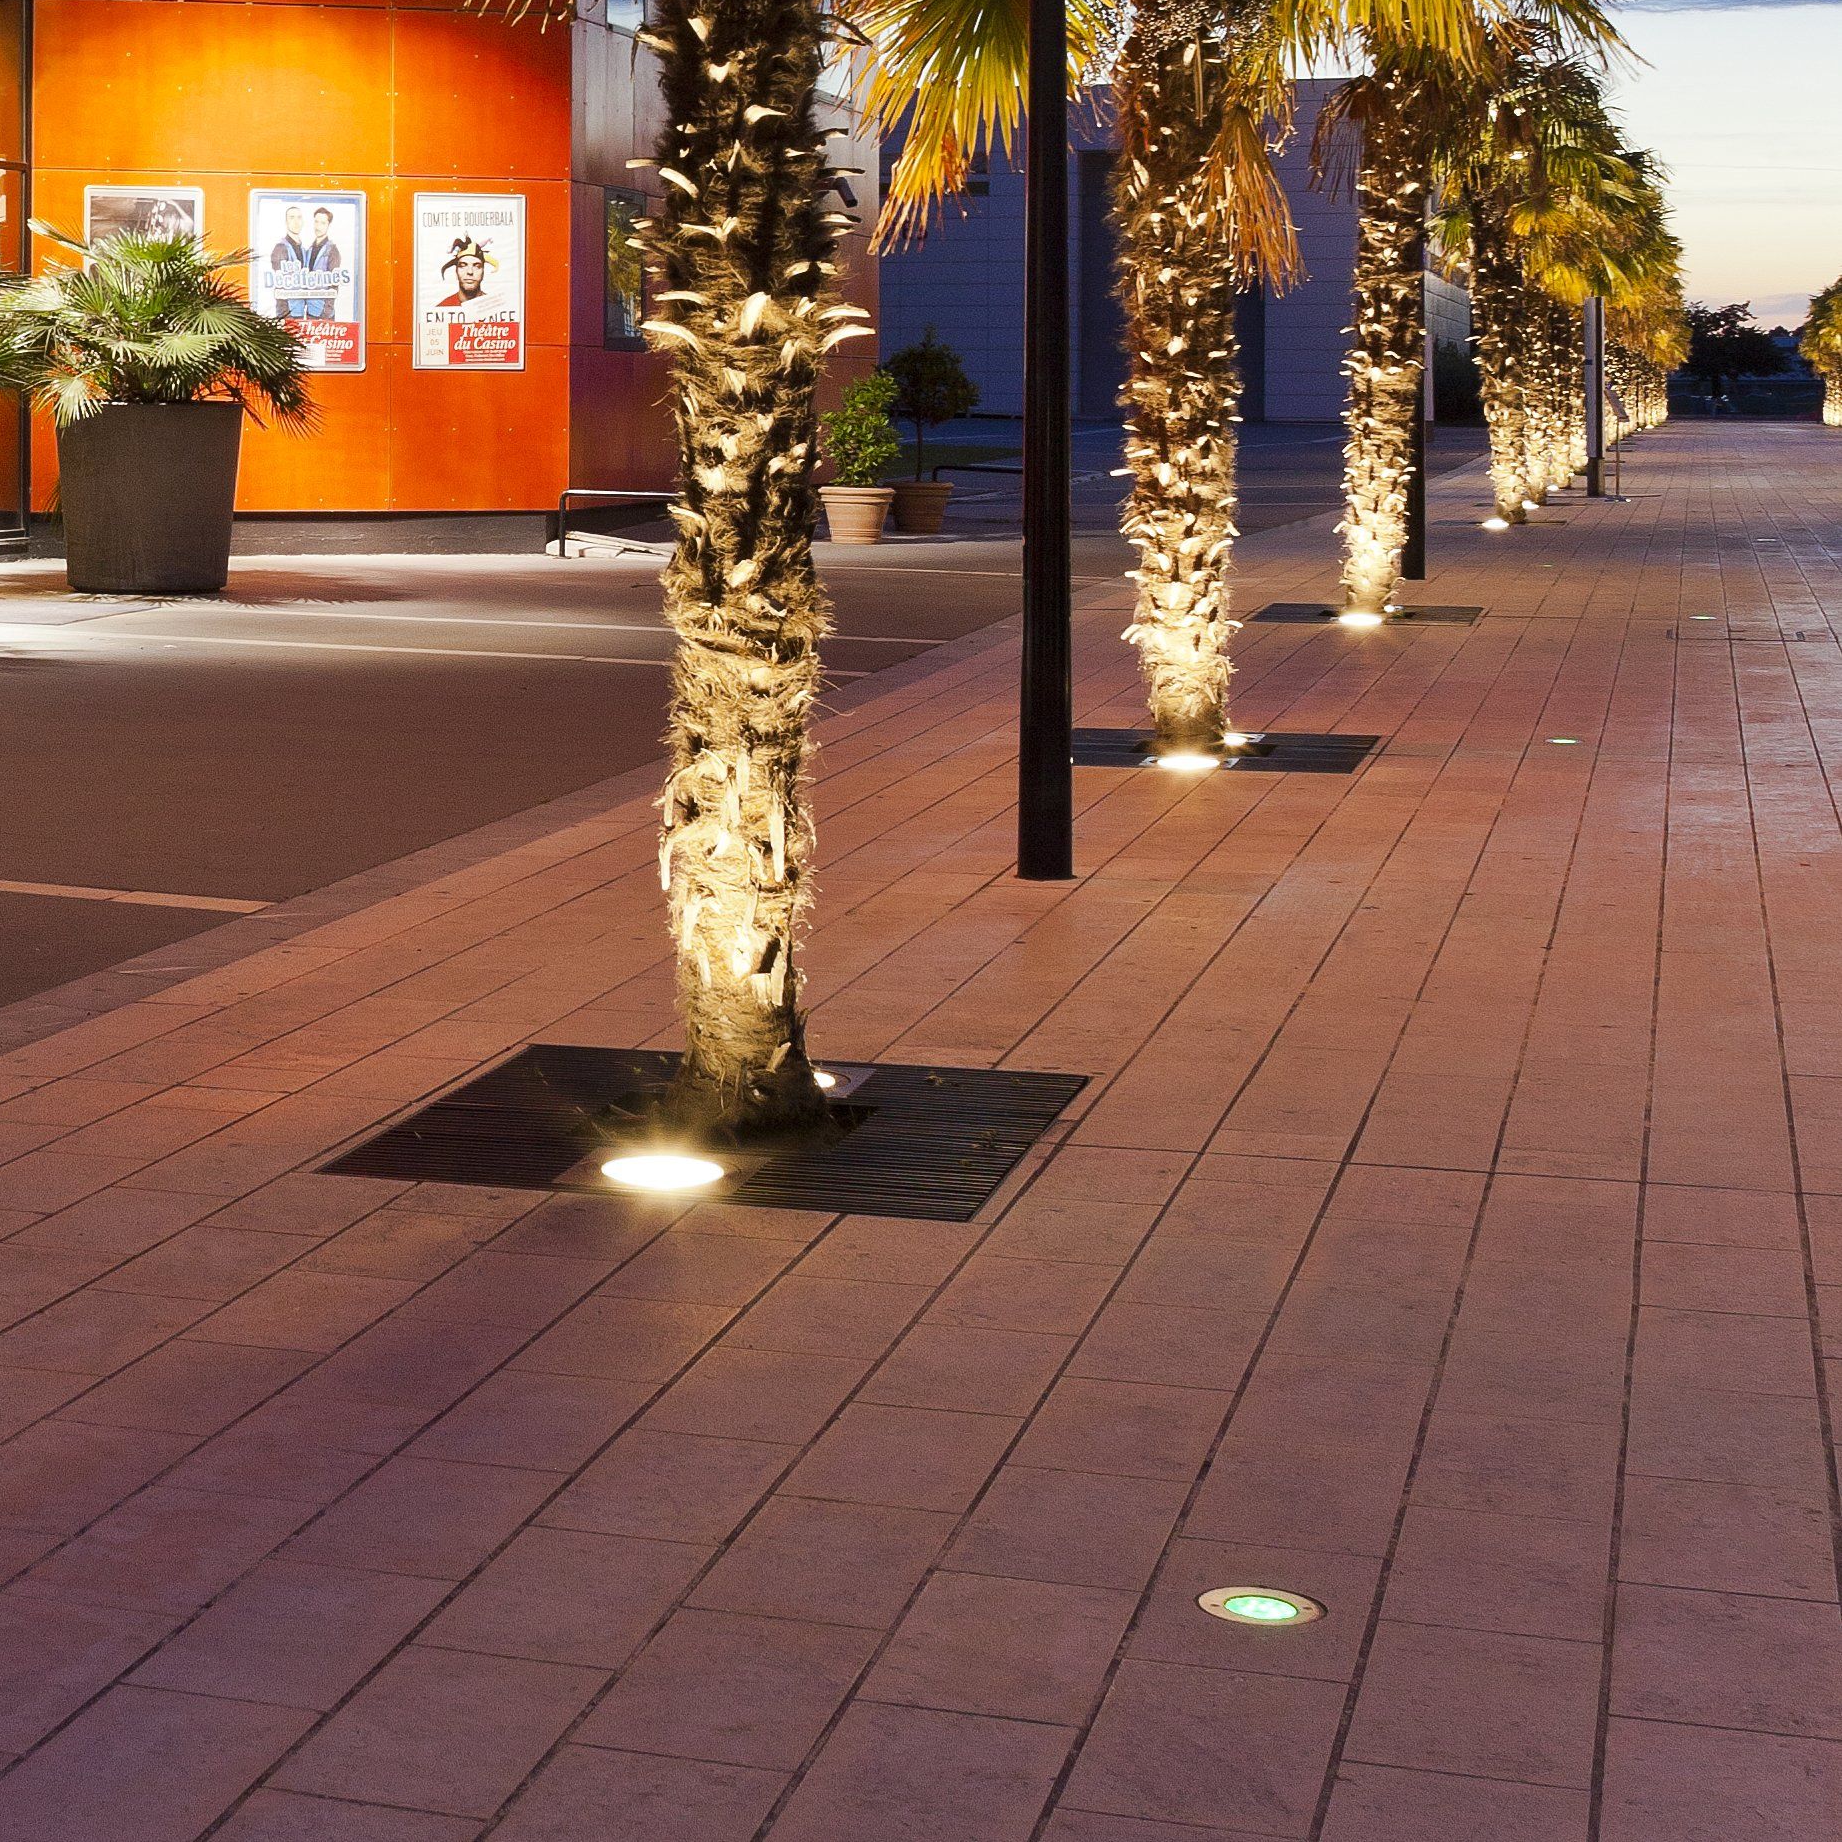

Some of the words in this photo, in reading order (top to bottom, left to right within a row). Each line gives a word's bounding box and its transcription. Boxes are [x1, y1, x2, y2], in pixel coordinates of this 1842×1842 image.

[423, 212, 449, 227] COMTE
[452, 212, 462, 227] DE
[464, 211, 514, 227] BOUDERBALA
[426, 328, 442, 337] JEU
[461, 323, 510, 338] Théâtre
[454, 336, 471, 351] du
[473, 336, 517, 350] Casino
